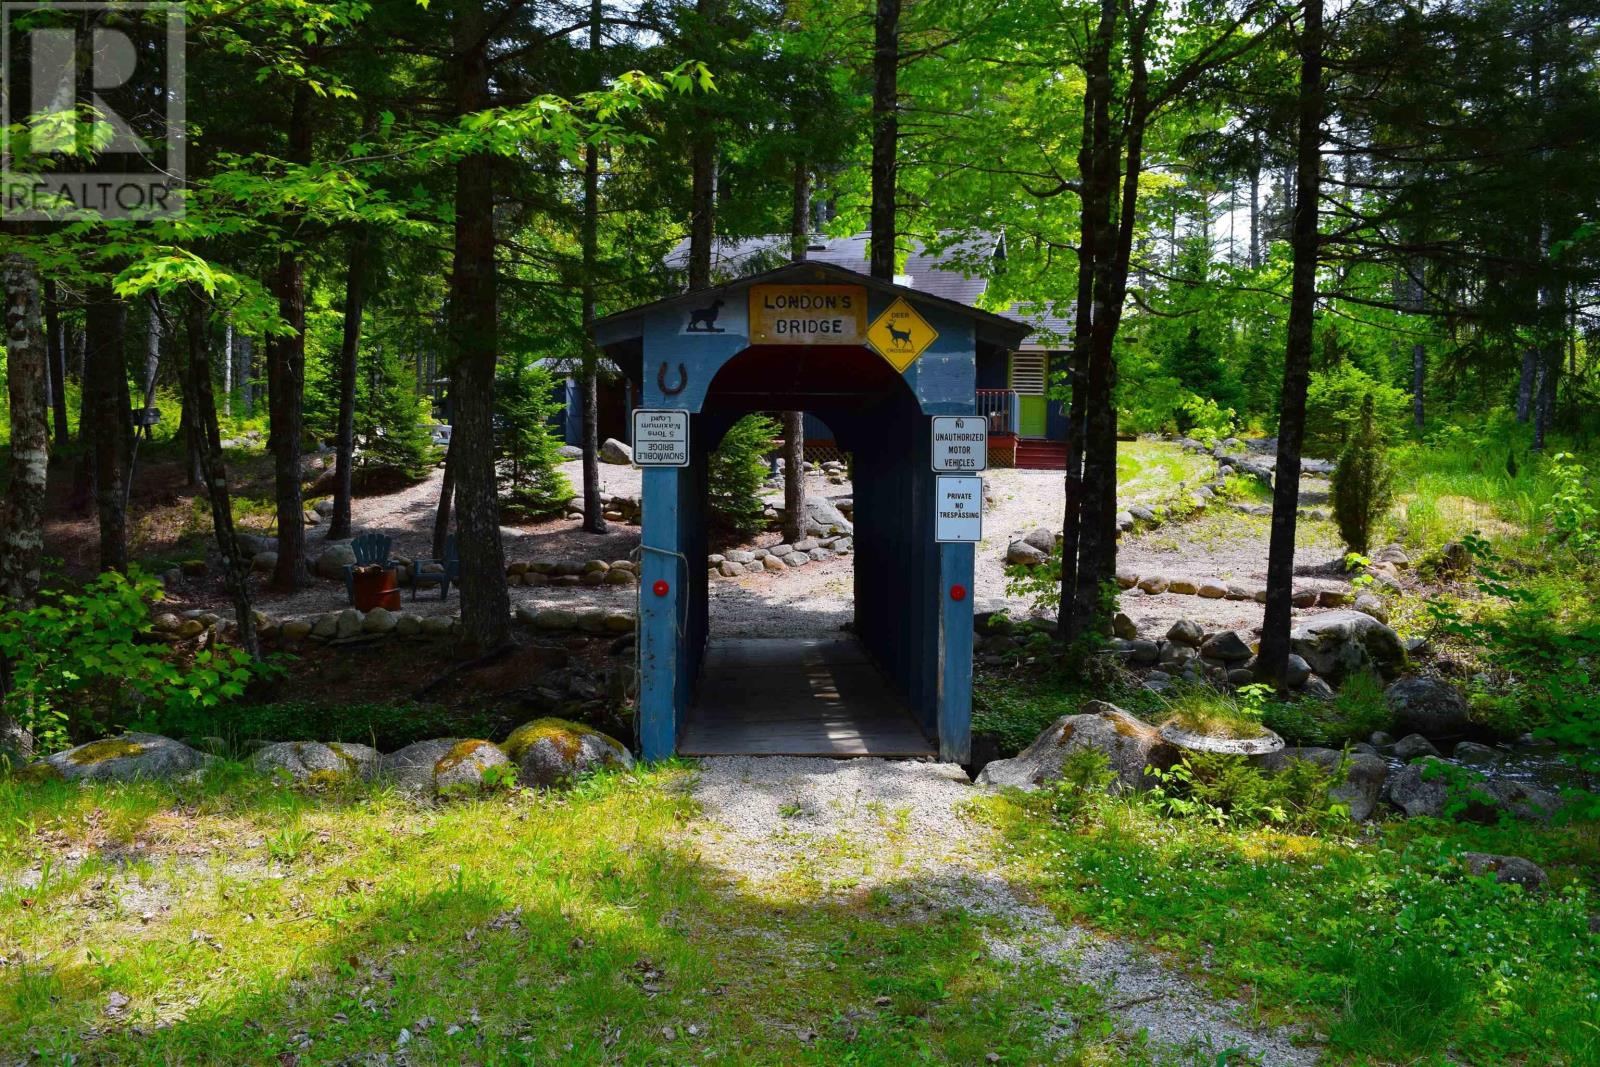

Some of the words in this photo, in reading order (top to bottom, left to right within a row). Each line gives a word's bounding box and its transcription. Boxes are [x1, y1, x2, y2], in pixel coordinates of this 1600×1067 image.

[776, 319, 842, 334] BRIDGE
[955, 420, 964, 428] NO
[935, 433, 984, 442] UNAUTHORIZED
[948, 445, 971, 454] MOTOR
[637, 452, 684, 460] SNOWMOBILE
[944, 458, 975, 467] VEHICLES
[946, 492, 972, 500] PRIVATE
[939, 511, 980, 519] TRESPASSING
